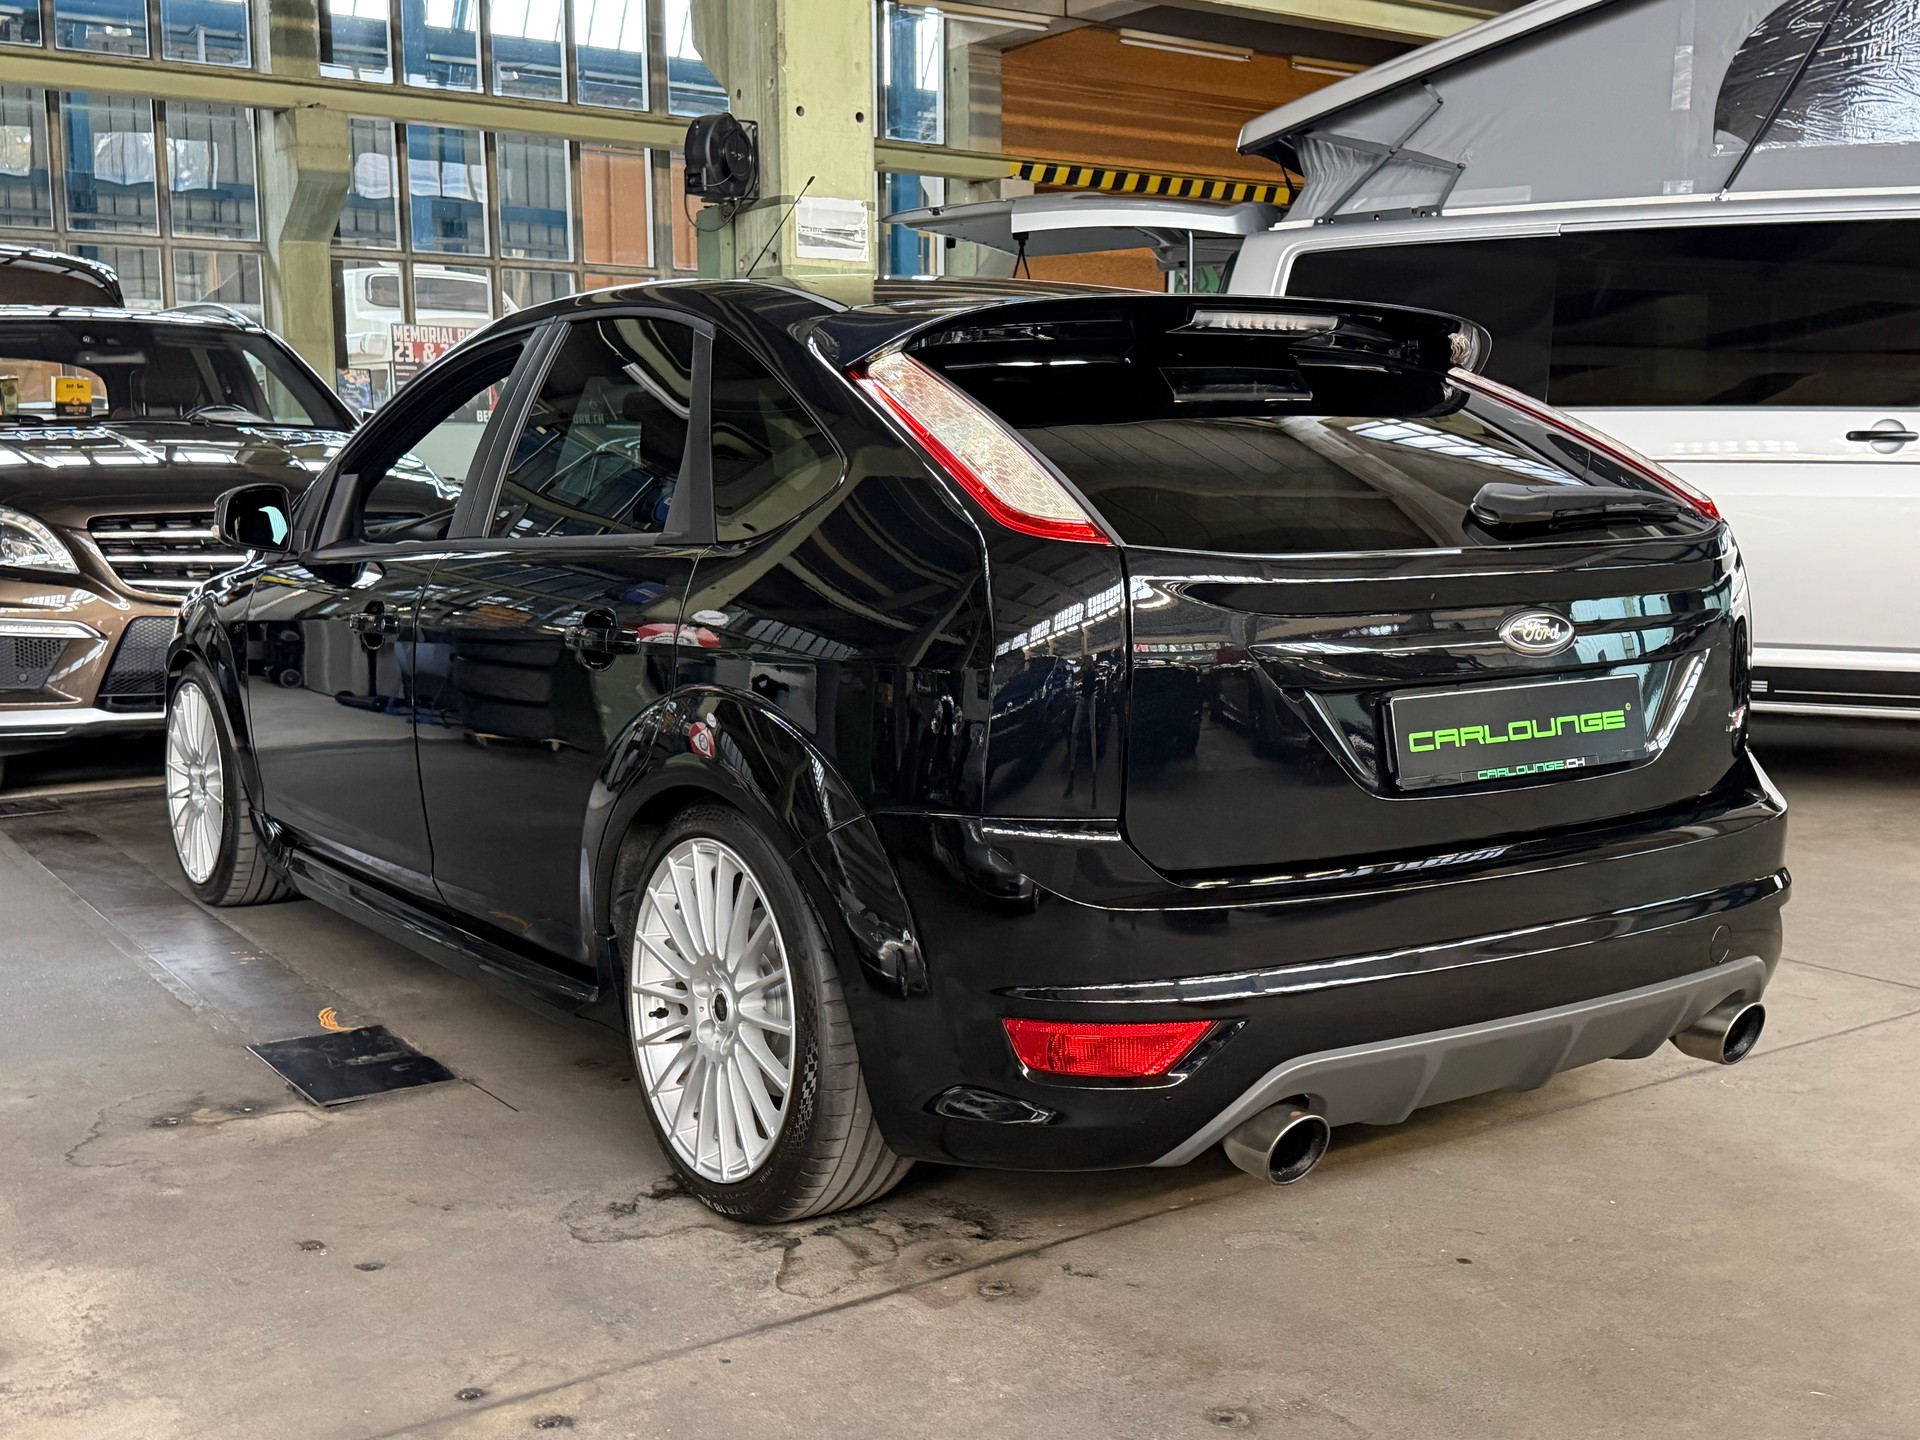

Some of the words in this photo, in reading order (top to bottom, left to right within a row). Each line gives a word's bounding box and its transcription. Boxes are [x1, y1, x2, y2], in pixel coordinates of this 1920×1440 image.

[393, 325, 456, 344] MEMORIAL
[393, 342, 420, 363] 23.
[1523, 618, 1560, 642] Ford
[1408, 710, 1626, 753] CARLOUNGE
[1477, 757, 1586, 781] CARLOUNGE.CH
